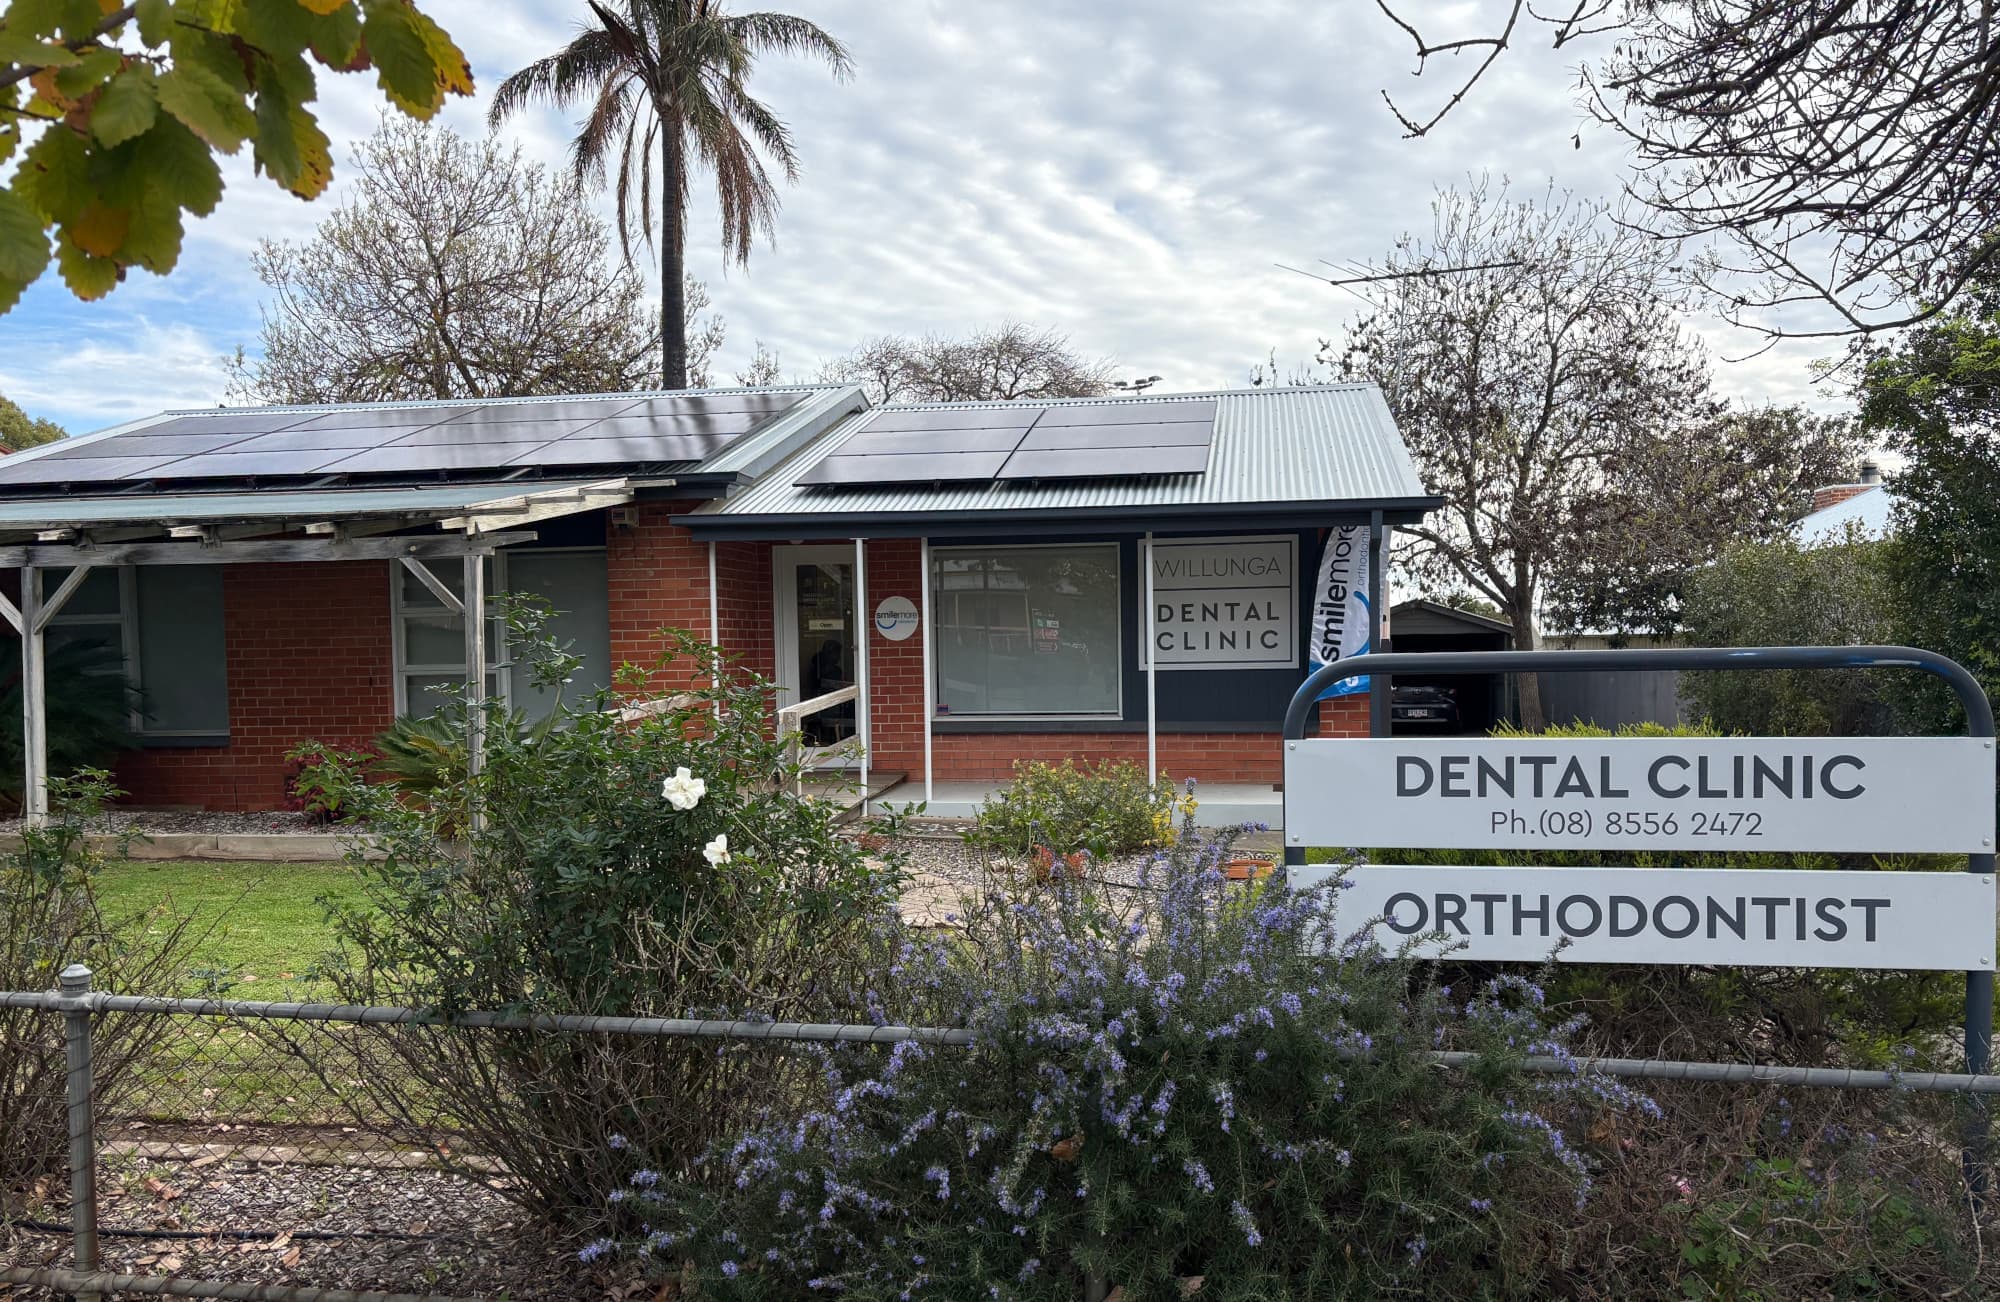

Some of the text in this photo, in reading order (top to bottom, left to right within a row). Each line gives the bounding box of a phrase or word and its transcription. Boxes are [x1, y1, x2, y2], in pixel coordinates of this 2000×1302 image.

[1154, 556, 1282, 578] WILLUNGA
[1157, 601, 1280, 623] DENTAL
[1156, 629, 1279, 651] CLINIC
[1397, 755, 1866, 800] DENTAL CLINIC
[1605, 812, 1679, 836] 8556
[1691, 812, 1763, 836] 2472
[1383, 892, 1891, 942] ORTHODONTIST
